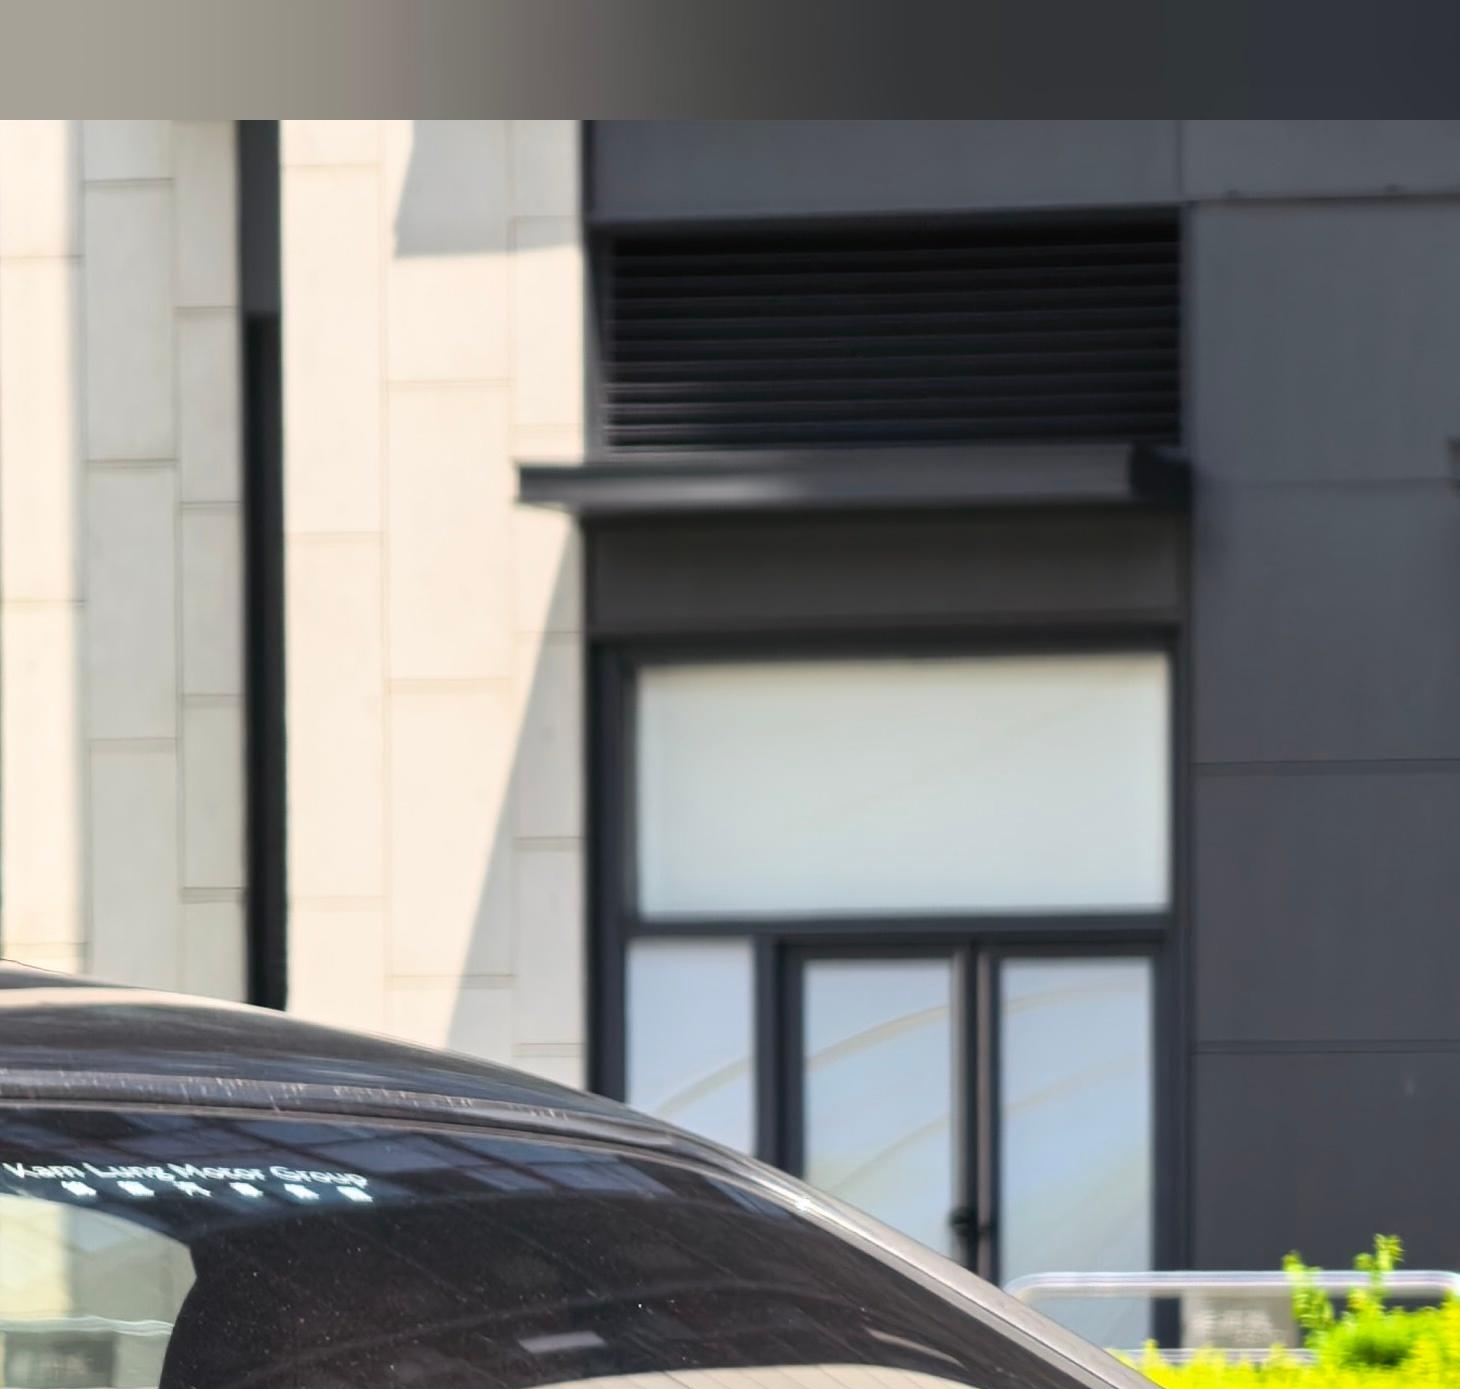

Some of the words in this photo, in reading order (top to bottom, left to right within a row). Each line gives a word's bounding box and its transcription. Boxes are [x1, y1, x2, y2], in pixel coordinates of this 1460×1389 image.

[2, 1162, 86, 1179] Kam
[83, 1162, 175, 1182] Lung
[168, 1163, 266, 1182] Motor
[270, 1166, 369, 1188] Group
